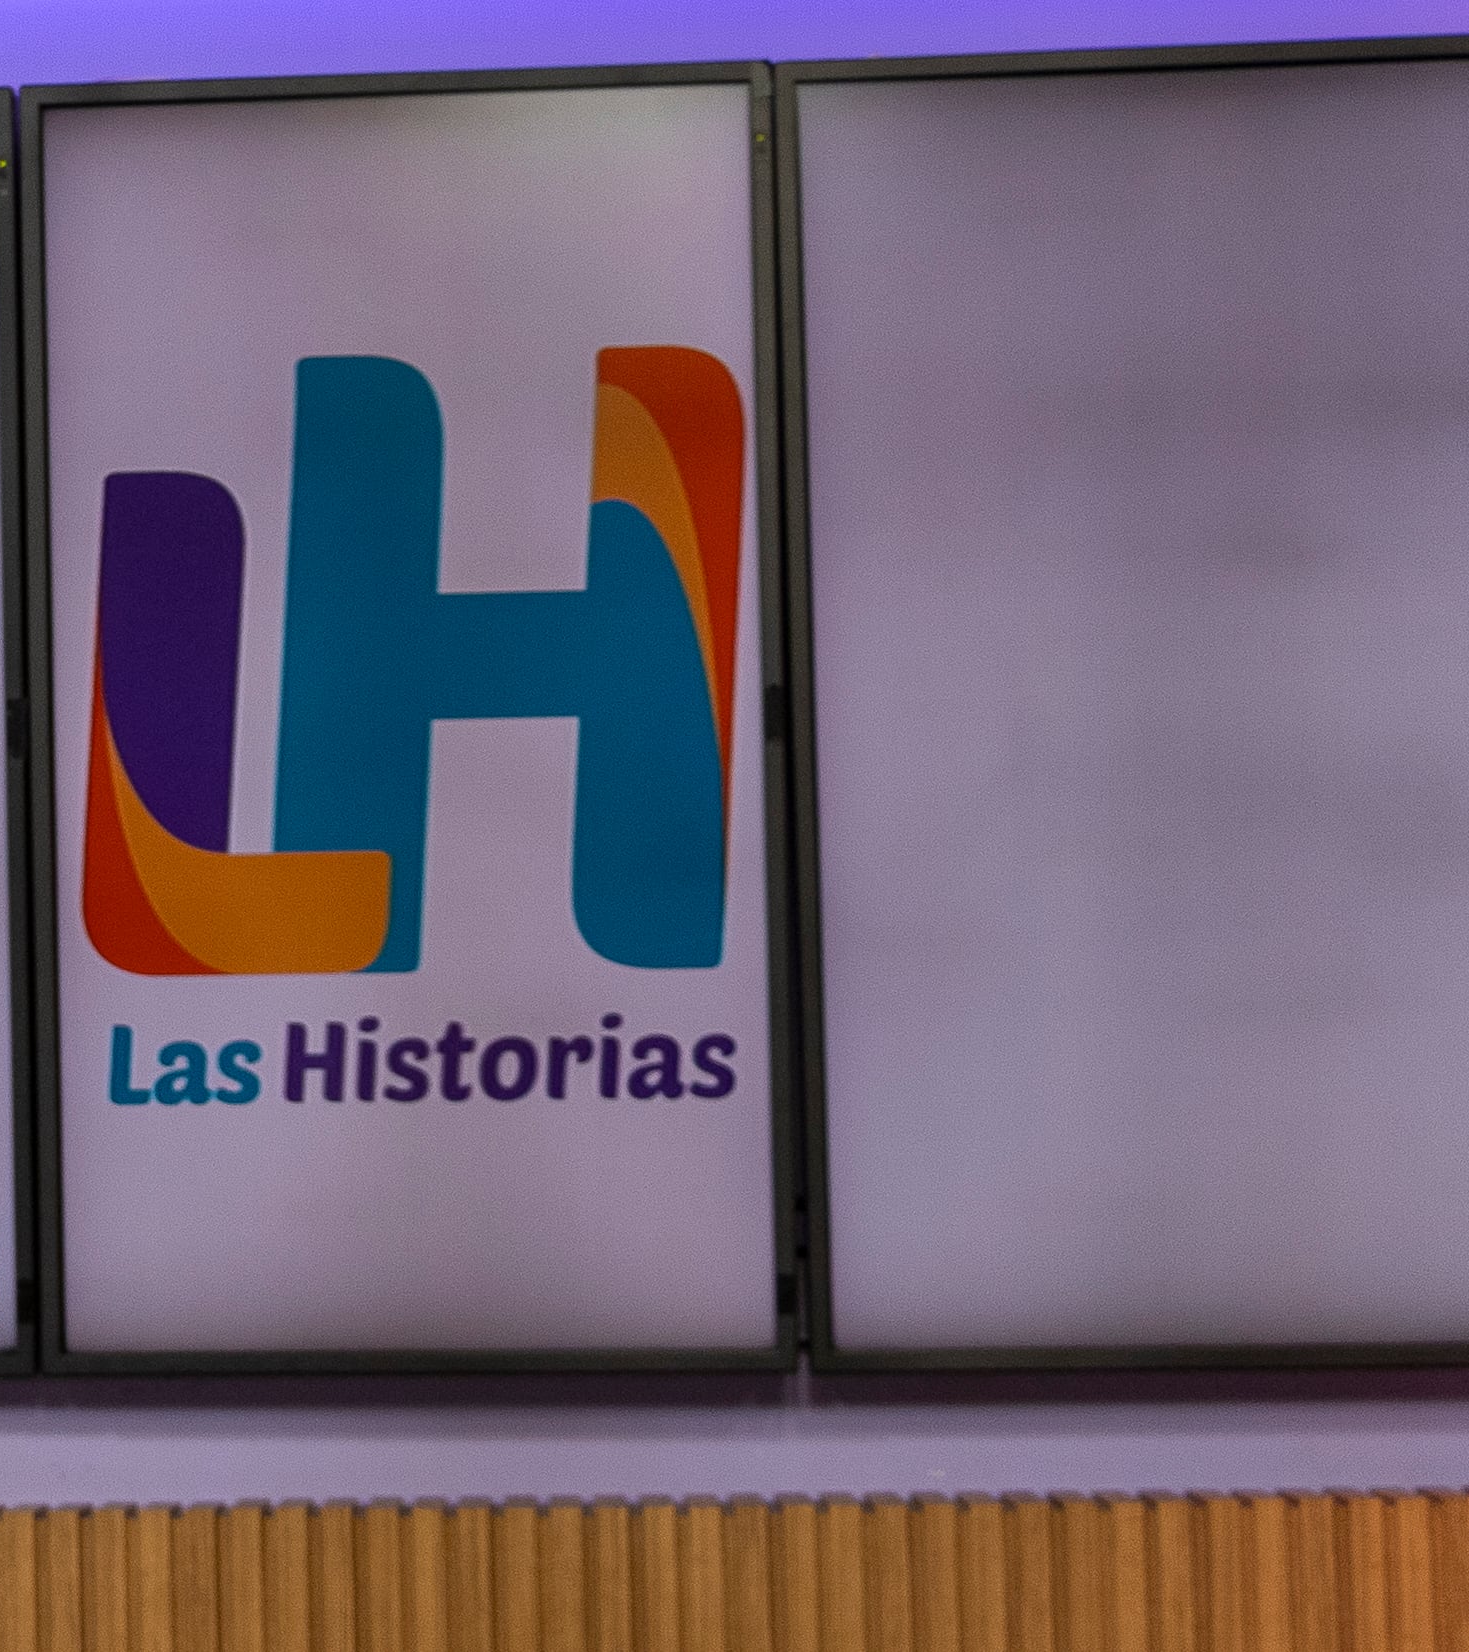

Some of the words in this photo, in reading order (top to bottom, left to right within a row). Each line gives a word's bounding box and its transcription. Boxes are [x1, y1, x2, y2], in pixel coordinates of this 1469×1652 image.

[81, 345, 746, 976] LH
[108, 1024, 262, 1105] Las
[283, 1013, 738, 1102] Historias
